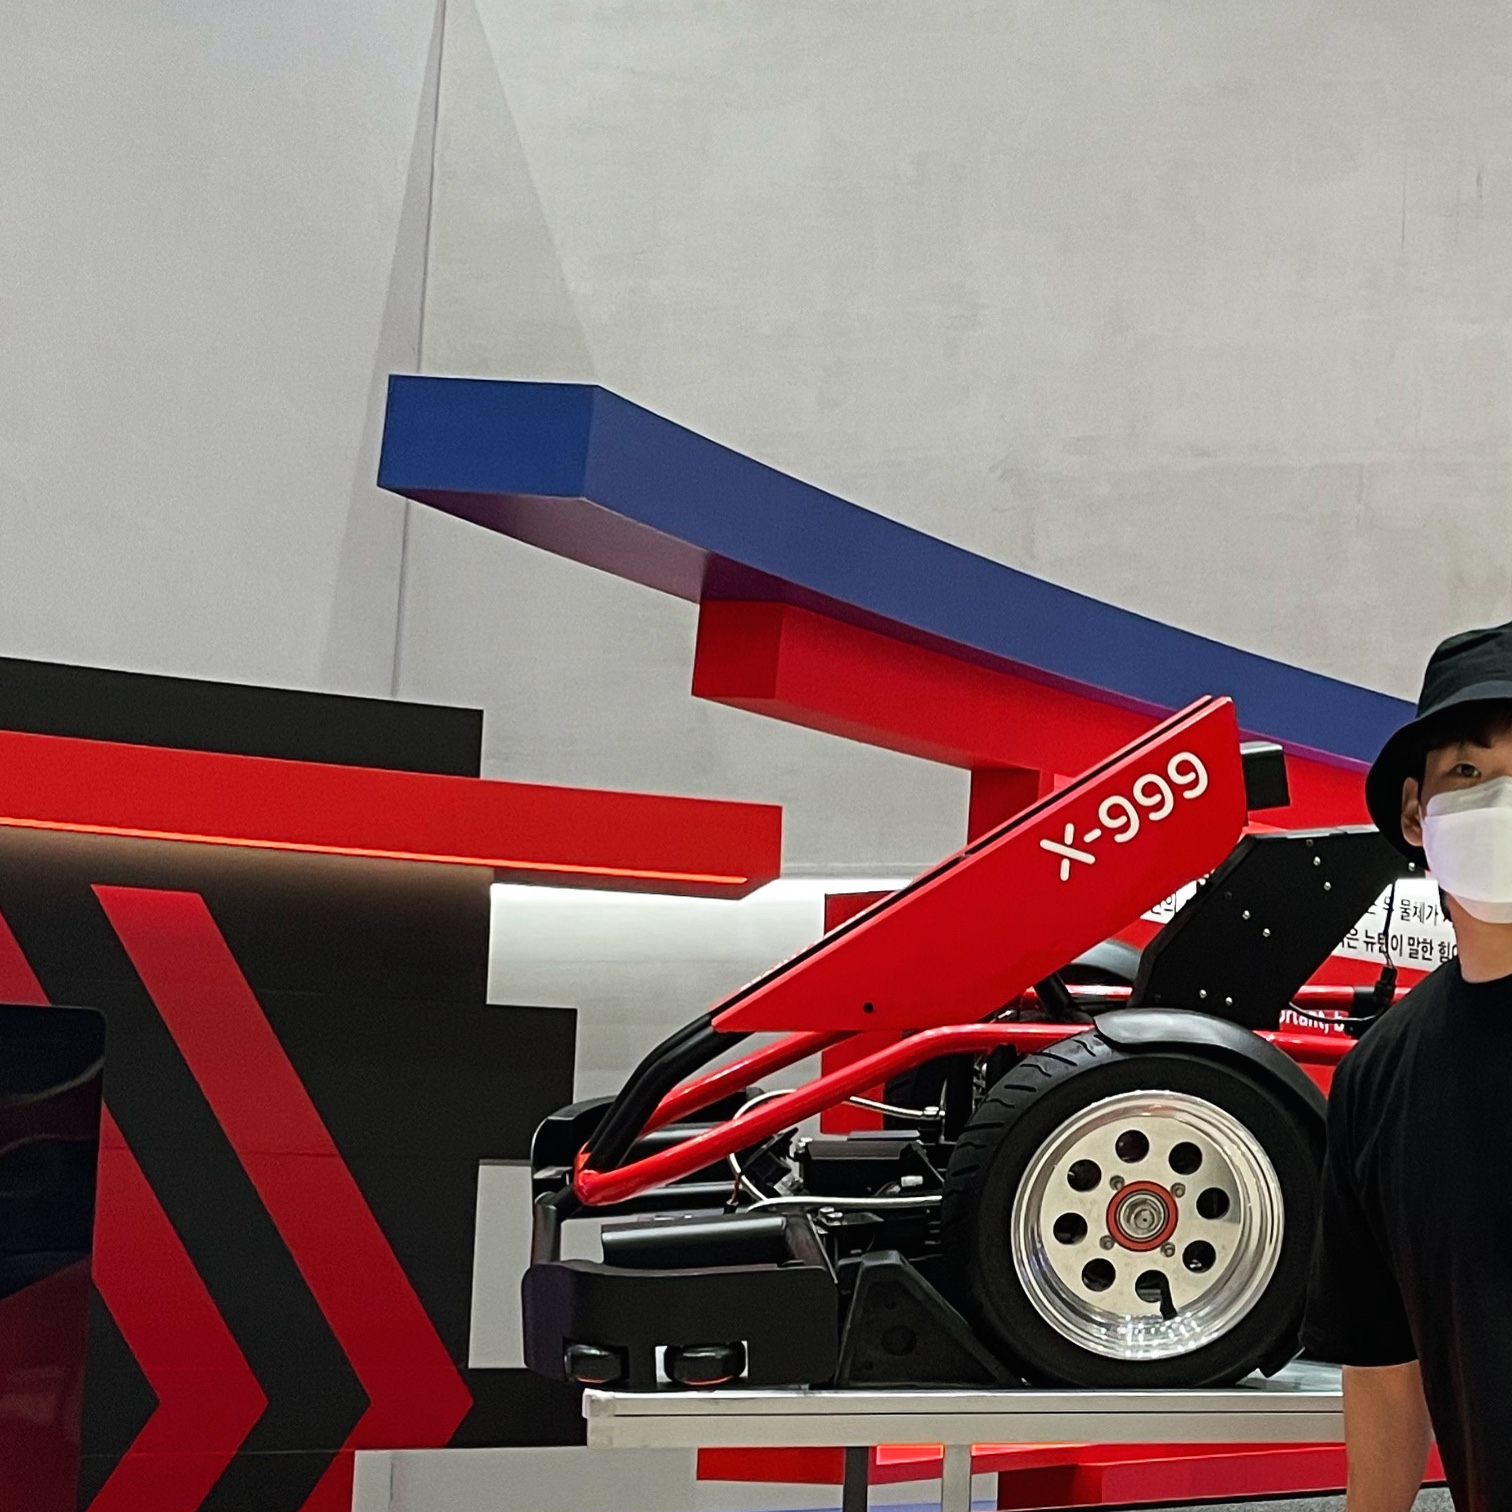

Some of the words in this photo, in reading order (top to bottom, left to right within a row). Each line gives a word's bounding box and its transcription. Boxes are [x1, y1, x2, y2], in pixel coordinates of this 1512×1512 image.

[1039, 751, 1208, 881] X-999
[1400, 899, 1439, 926] 물체가
[1341, 928, 1360, 950] 은
[1408, 936, 1434, 961] 말한
